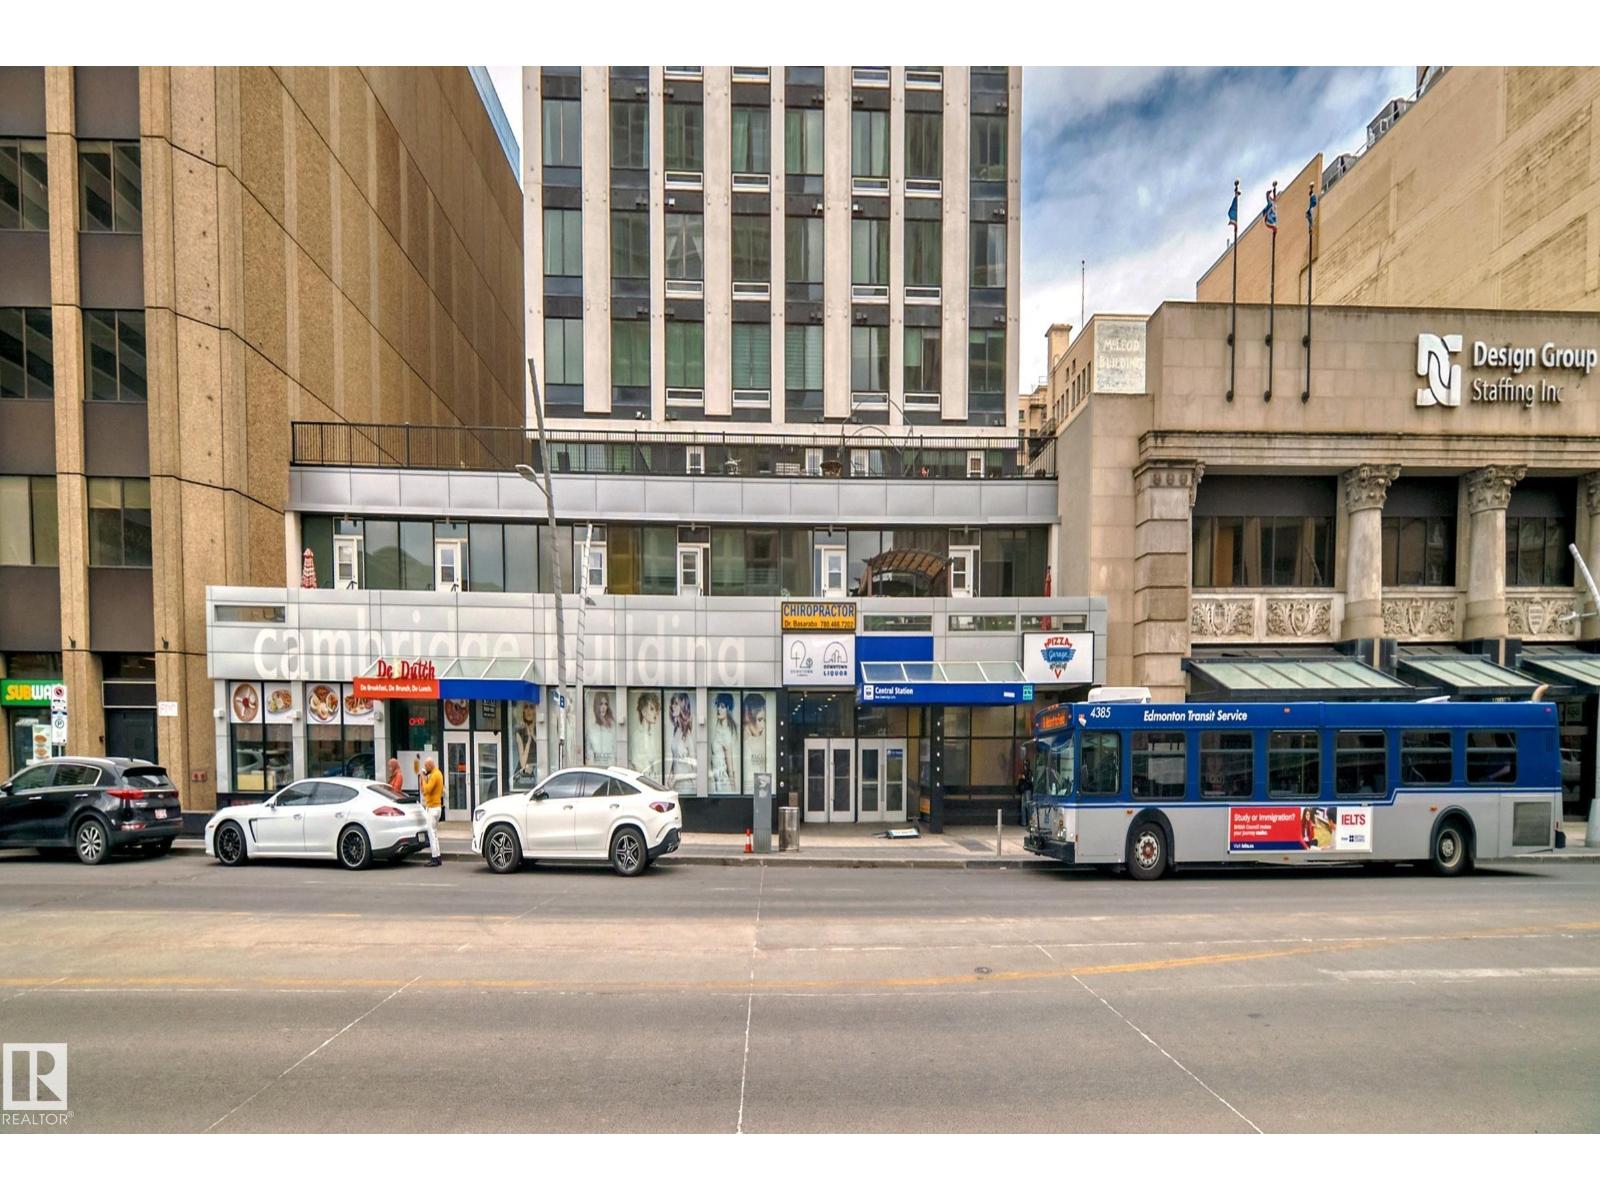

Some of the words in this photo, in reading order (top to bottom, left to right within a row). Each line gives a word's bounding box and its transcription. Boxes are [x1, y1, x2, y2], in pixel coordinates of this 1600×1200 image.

[1473, 341, 1536, 374] Design
[1541, 342, 1598, 374] Group
[1473, 377, 1536, 407] Staffing
[783, 604, 855, 617] CHIROPRACTOR
[1045, 637, 1070, 647] PIZZA
[377, 659, 393, 679] De
[401, 660, 436, 680] Dutch
[6, 684, 52, 700] SUBWA
[875, 686, 894, 695] Central
[894, 687, 914, 695] Station
[1090, 706, 1111, 719] 4385
[1143, 710, 1186, 722] Edmonton
[1188, 710, 1214, 722] Transit
[1217, 709, 1248, 721] Service
[1234, 814, 1250, 823] Study
[1341, 814, 1366, 826] IELTS
